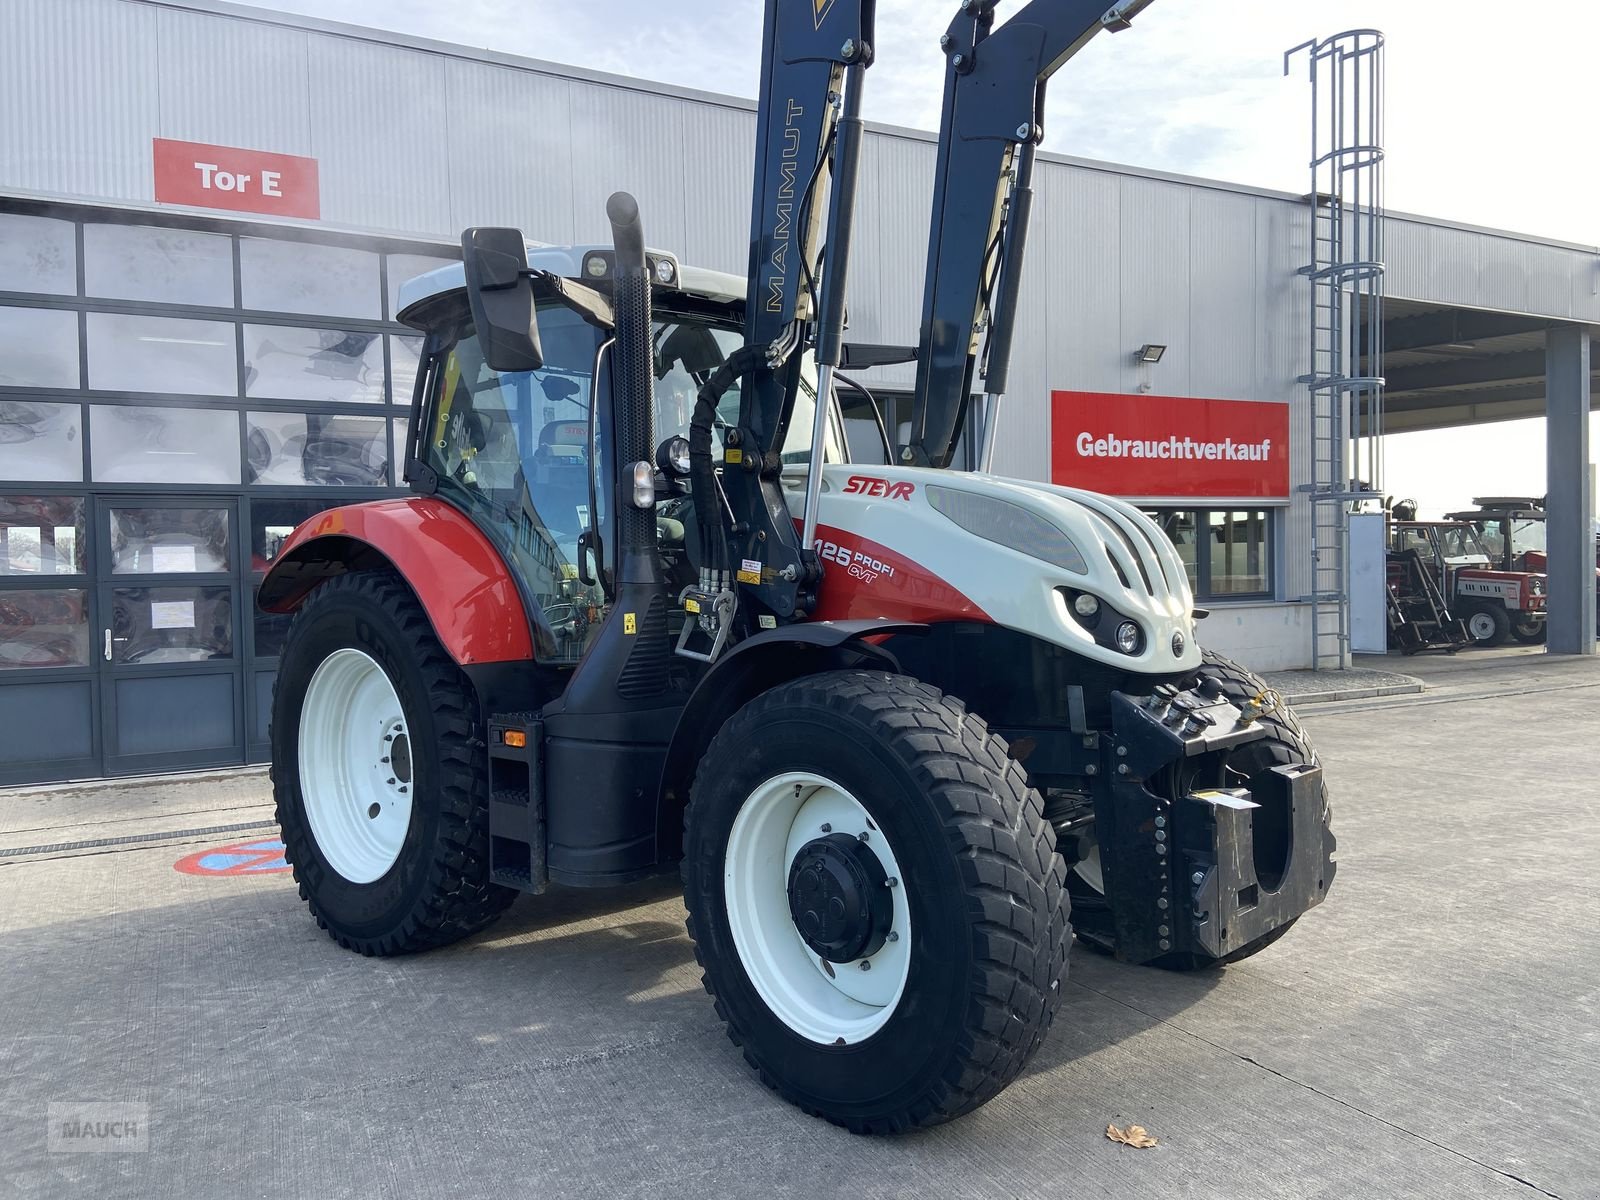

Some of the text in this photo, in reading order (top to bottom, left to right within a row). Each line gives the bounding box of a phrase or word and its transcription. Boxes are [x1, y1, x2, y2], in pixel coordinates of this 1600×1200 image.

[194, 162, 282, 197] Tor E
[766, 98, 803, 313] MAMMUT
[1076, 432, 1271, 461] Gebrauchtverkauf
[842, 475, 915, 501] STEYR
[847, 563, 878, 584] CVT
[853, 551, 895, 577] PROFI
